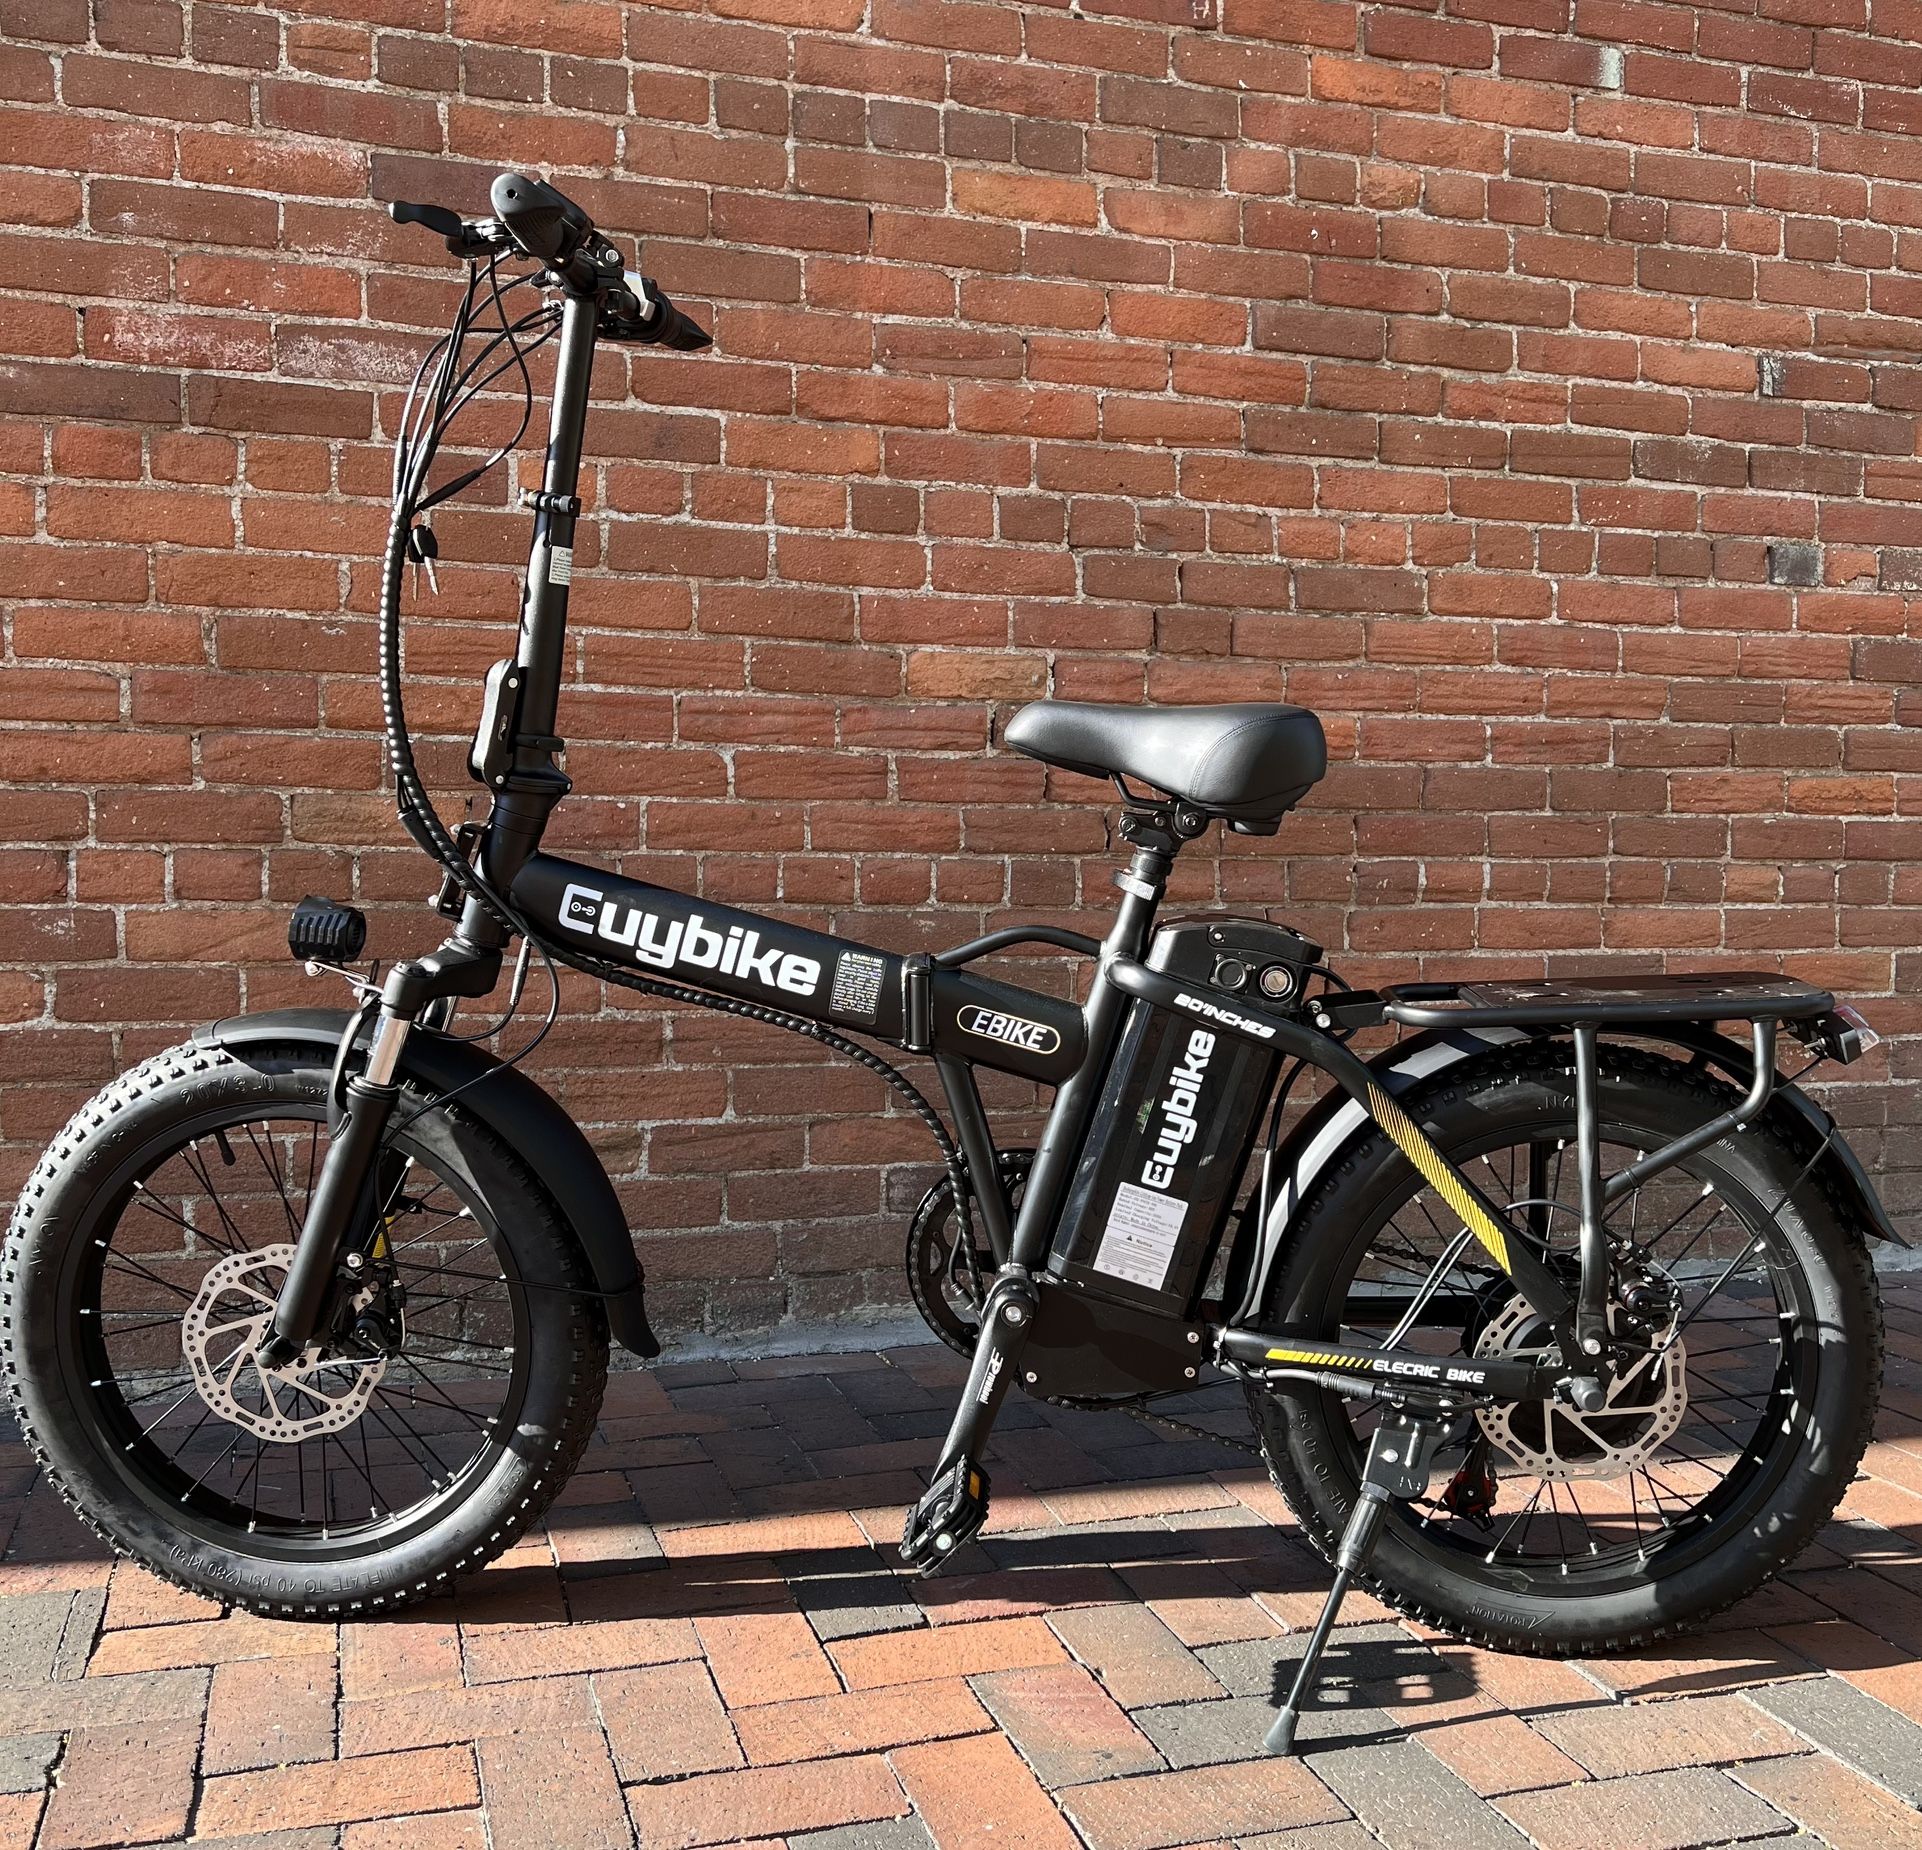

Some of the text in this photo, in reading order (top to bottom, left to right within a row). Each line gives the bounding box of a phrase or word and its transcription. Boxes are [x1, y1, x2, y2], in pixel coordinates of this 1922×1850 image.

[558, 883, 821, 996] Euybike
[971, 1010, 1048, 1049] EBIKE
[1141, 1029, 1216, 1189] Euybike
[1372, 1359, 1486, 1384] ELECRIC BIKE
